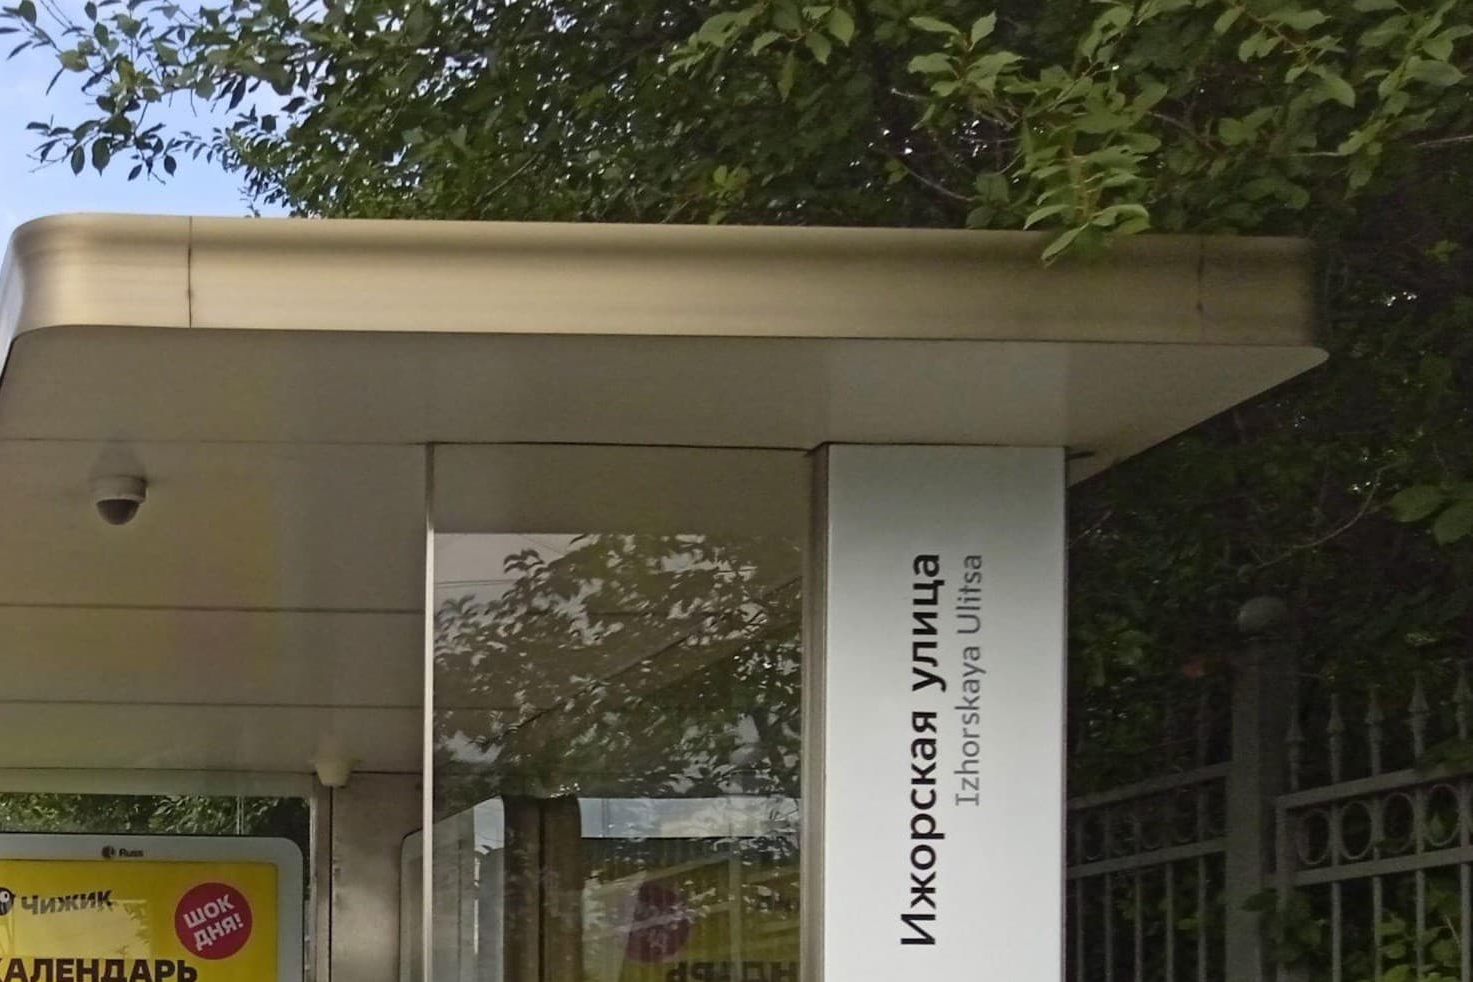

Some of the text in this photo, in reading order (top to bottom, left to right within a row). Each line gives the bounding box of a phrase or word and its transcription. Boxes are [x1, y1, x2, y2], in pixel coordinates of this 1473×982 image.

[900, 553, 947, 946] Ижорская улица
[954, 554, 987, 807] Izhorskaya Ulitsa
[183, 894, 235, 930] ШОК
[193, 912, 245, 952] ДНЯ!
